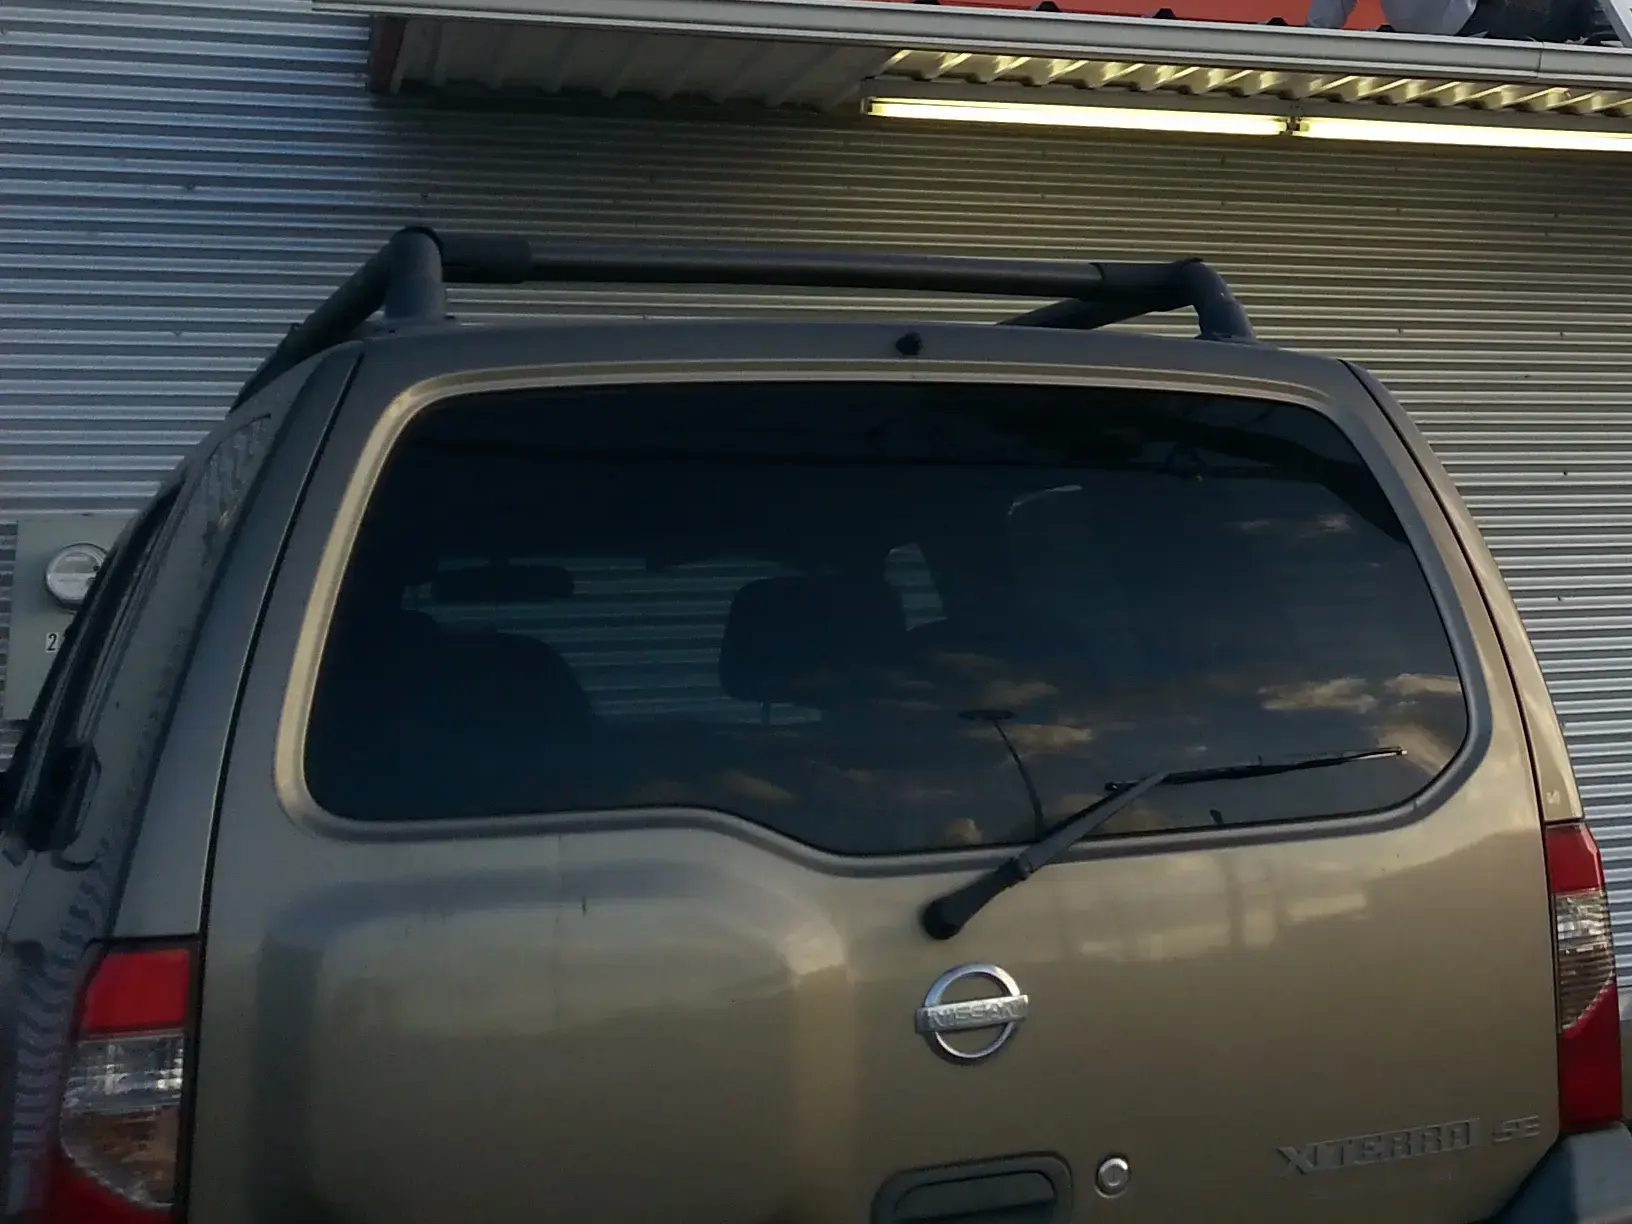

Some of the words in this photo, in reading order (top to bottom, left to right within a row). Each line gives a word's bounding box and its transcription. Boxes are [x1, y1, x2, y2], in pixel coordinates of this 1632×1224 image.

[929, 996, 1022, 1031] NISSAN
[1277, 1117, 1480, 1175] XTERRA
[1492, 1115, 1541, 1143] SE
